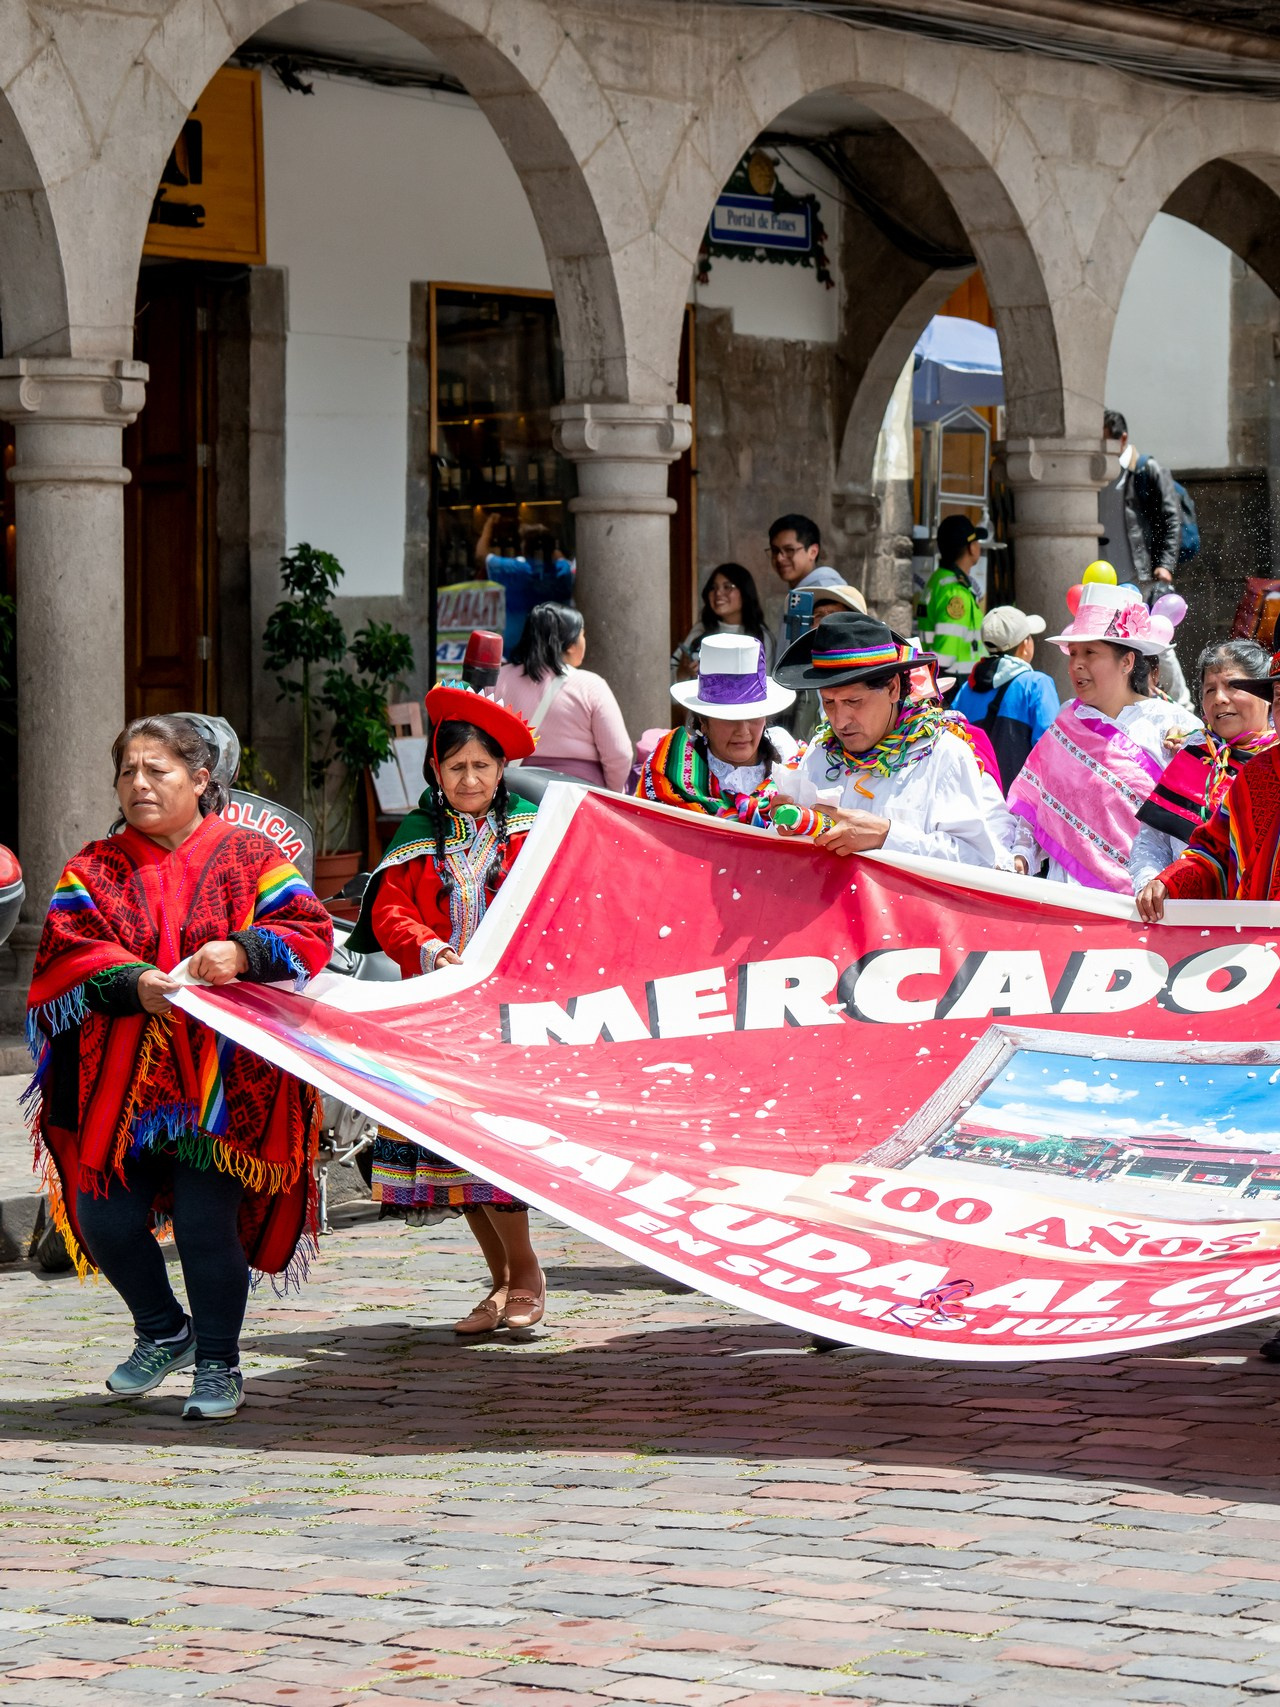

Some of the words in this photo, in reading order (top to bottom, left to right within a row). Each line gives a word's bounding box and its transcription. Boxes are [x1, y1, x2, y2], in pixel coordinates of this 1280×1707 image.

[726, 208, 756, 228] Portal
[757, 212, 769, 230] de
[771, 212, 797, 233] Panes
[220, 801, 305, 863] OLICIA
[470, 1111, 951, 1301] SALUDA
[964, 1278, 1129, 1313] AL
[830, 1173, 993, 1225] 100
[1005, 1216, 1262, 1258] AÑOS
[614, 1211, 722, 1257] EN
[714, 1254, 823, 1294] SU
[812, 1288, 978, 1331] MES
[970, 1290, 1280, 1337] JUBILAR
